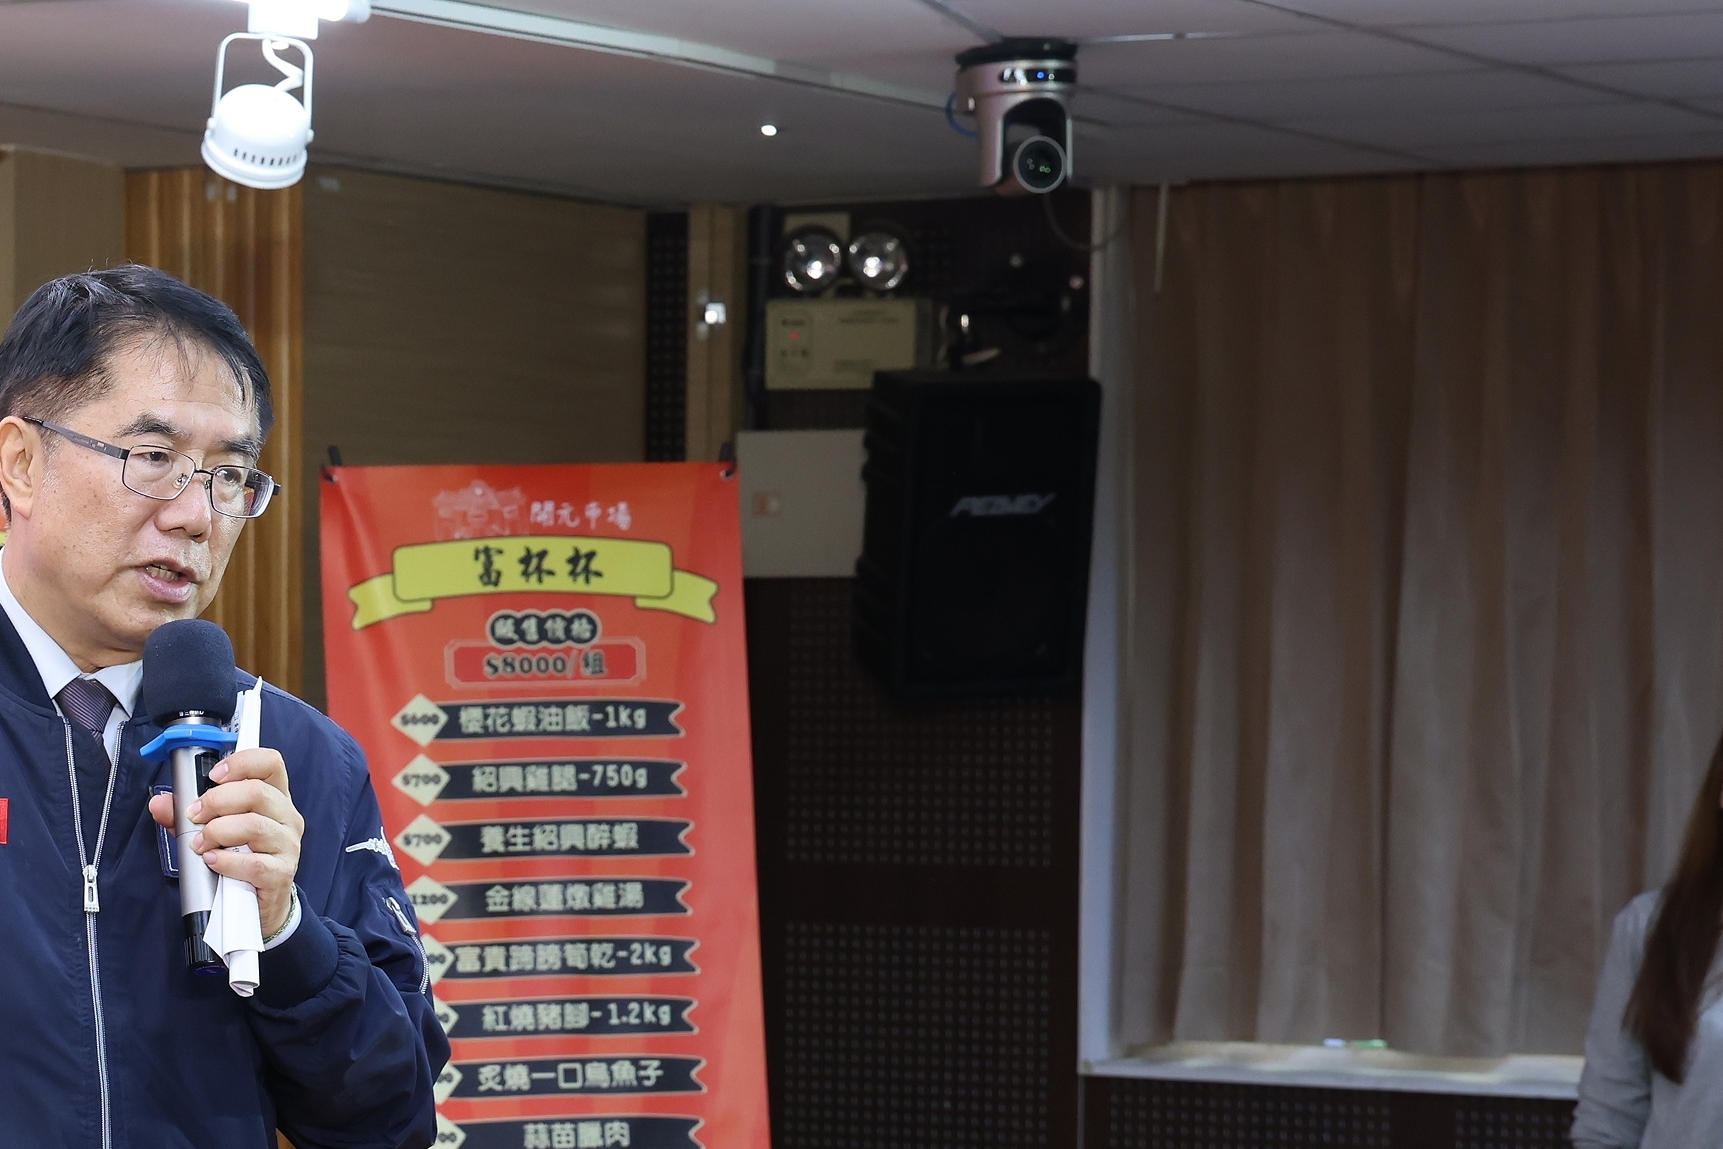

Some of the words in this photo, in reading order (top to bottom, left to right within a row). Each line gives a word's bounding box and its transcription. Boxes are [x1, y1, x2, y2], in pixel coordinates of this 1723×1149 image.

[530, 501, 632, 531] 開元市場
[474, 547, 604, 588] 富杯杯
[485, 651, 606, 676] $8000/組
[410, 891, 448, 906] 1200
